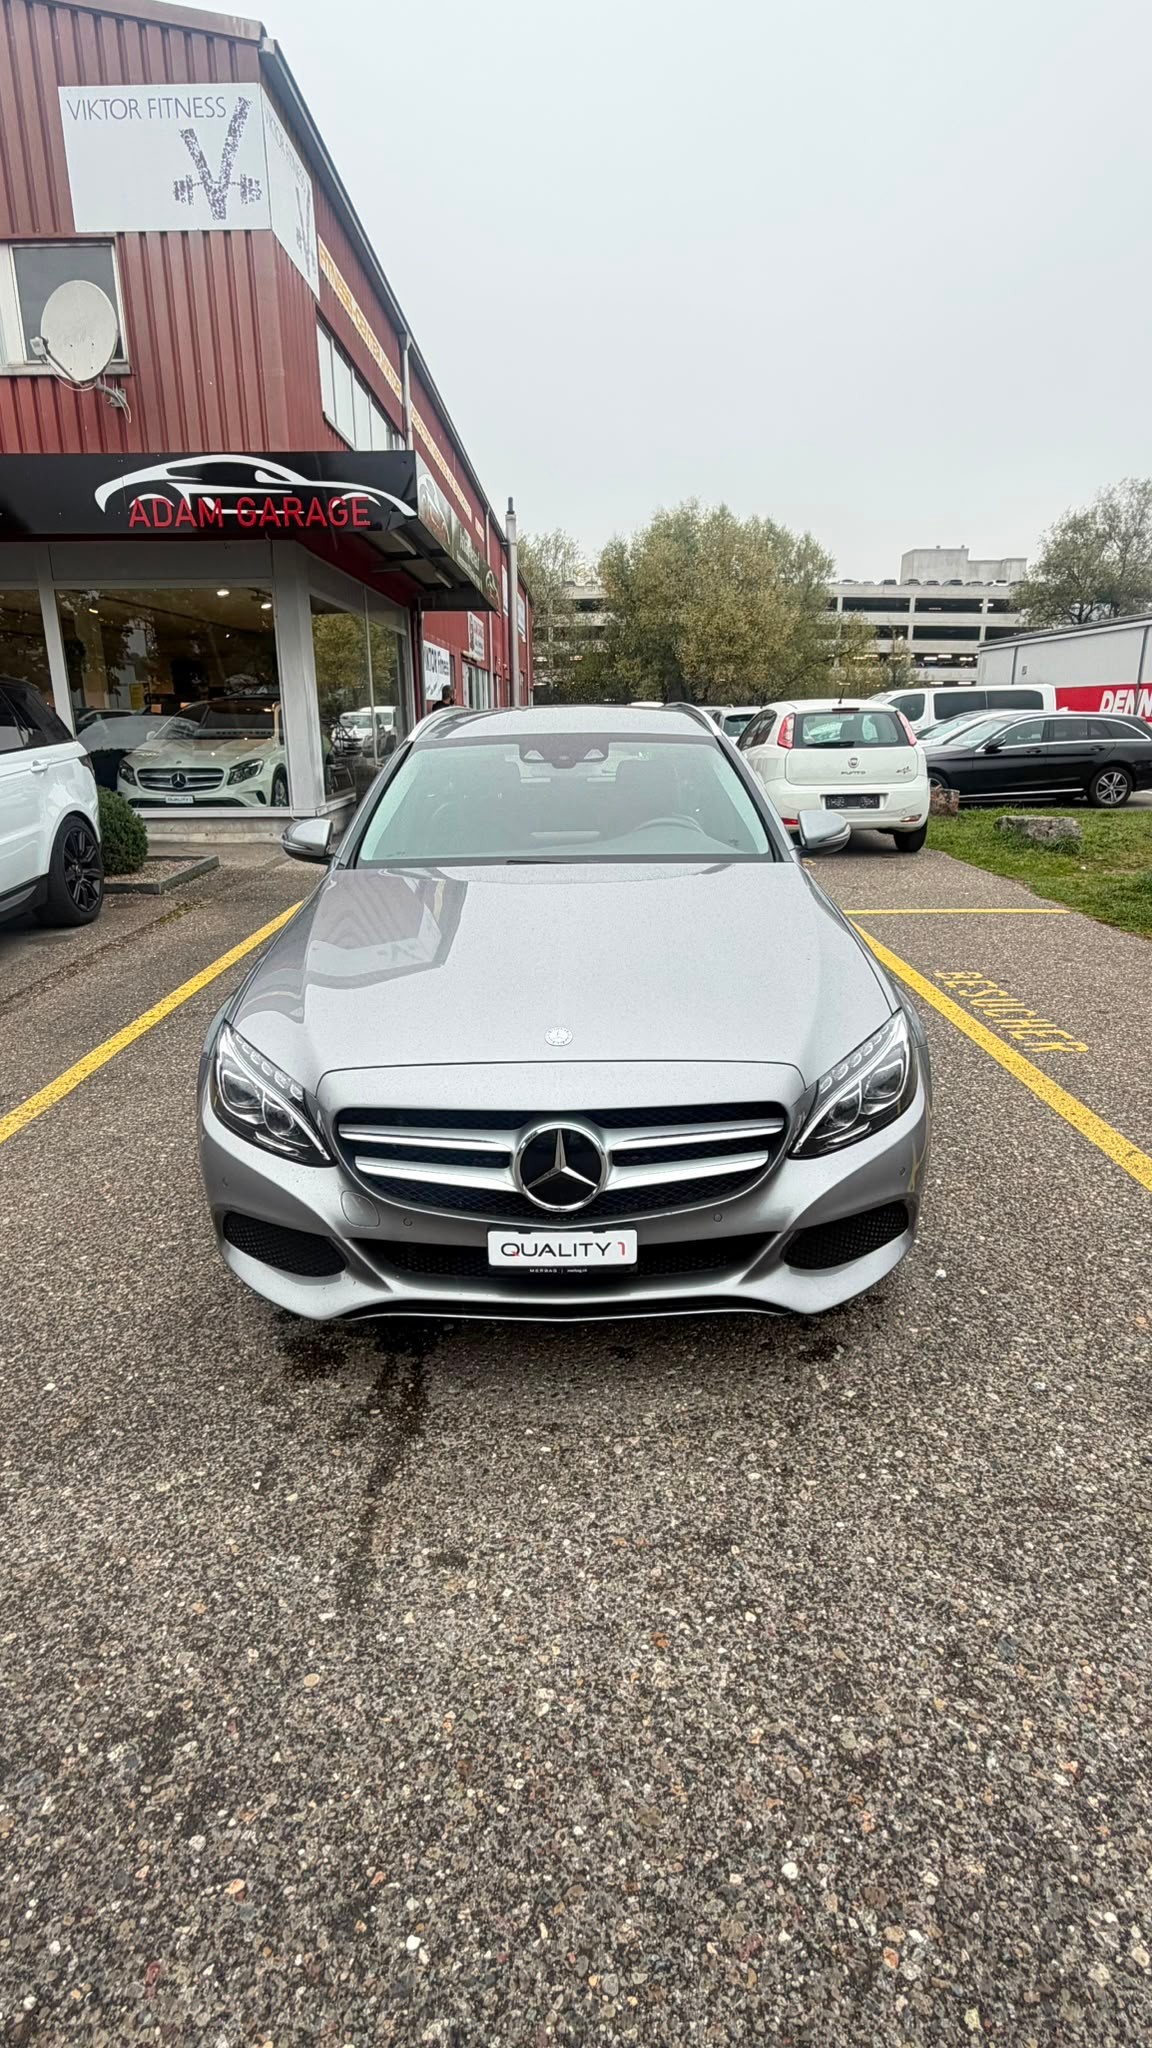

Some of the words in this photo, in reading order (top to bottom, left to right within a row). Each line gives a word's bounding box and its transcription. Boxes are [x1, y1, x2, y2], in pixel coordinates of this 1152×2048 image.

[66, 98, 142, 121] VIKTOR
[149, 96, 227, 119] FITNESS
[128, 497, 224, 528] ADAM
[236, 496, 372, 527] GARAGE
[1021, 665, 1028, 676] 5
[933, 971, 1090, 1053] BESUCHER
[501, 1241, 612, 1257] QUALITY
[617, 1241, 626, 1256] 1
